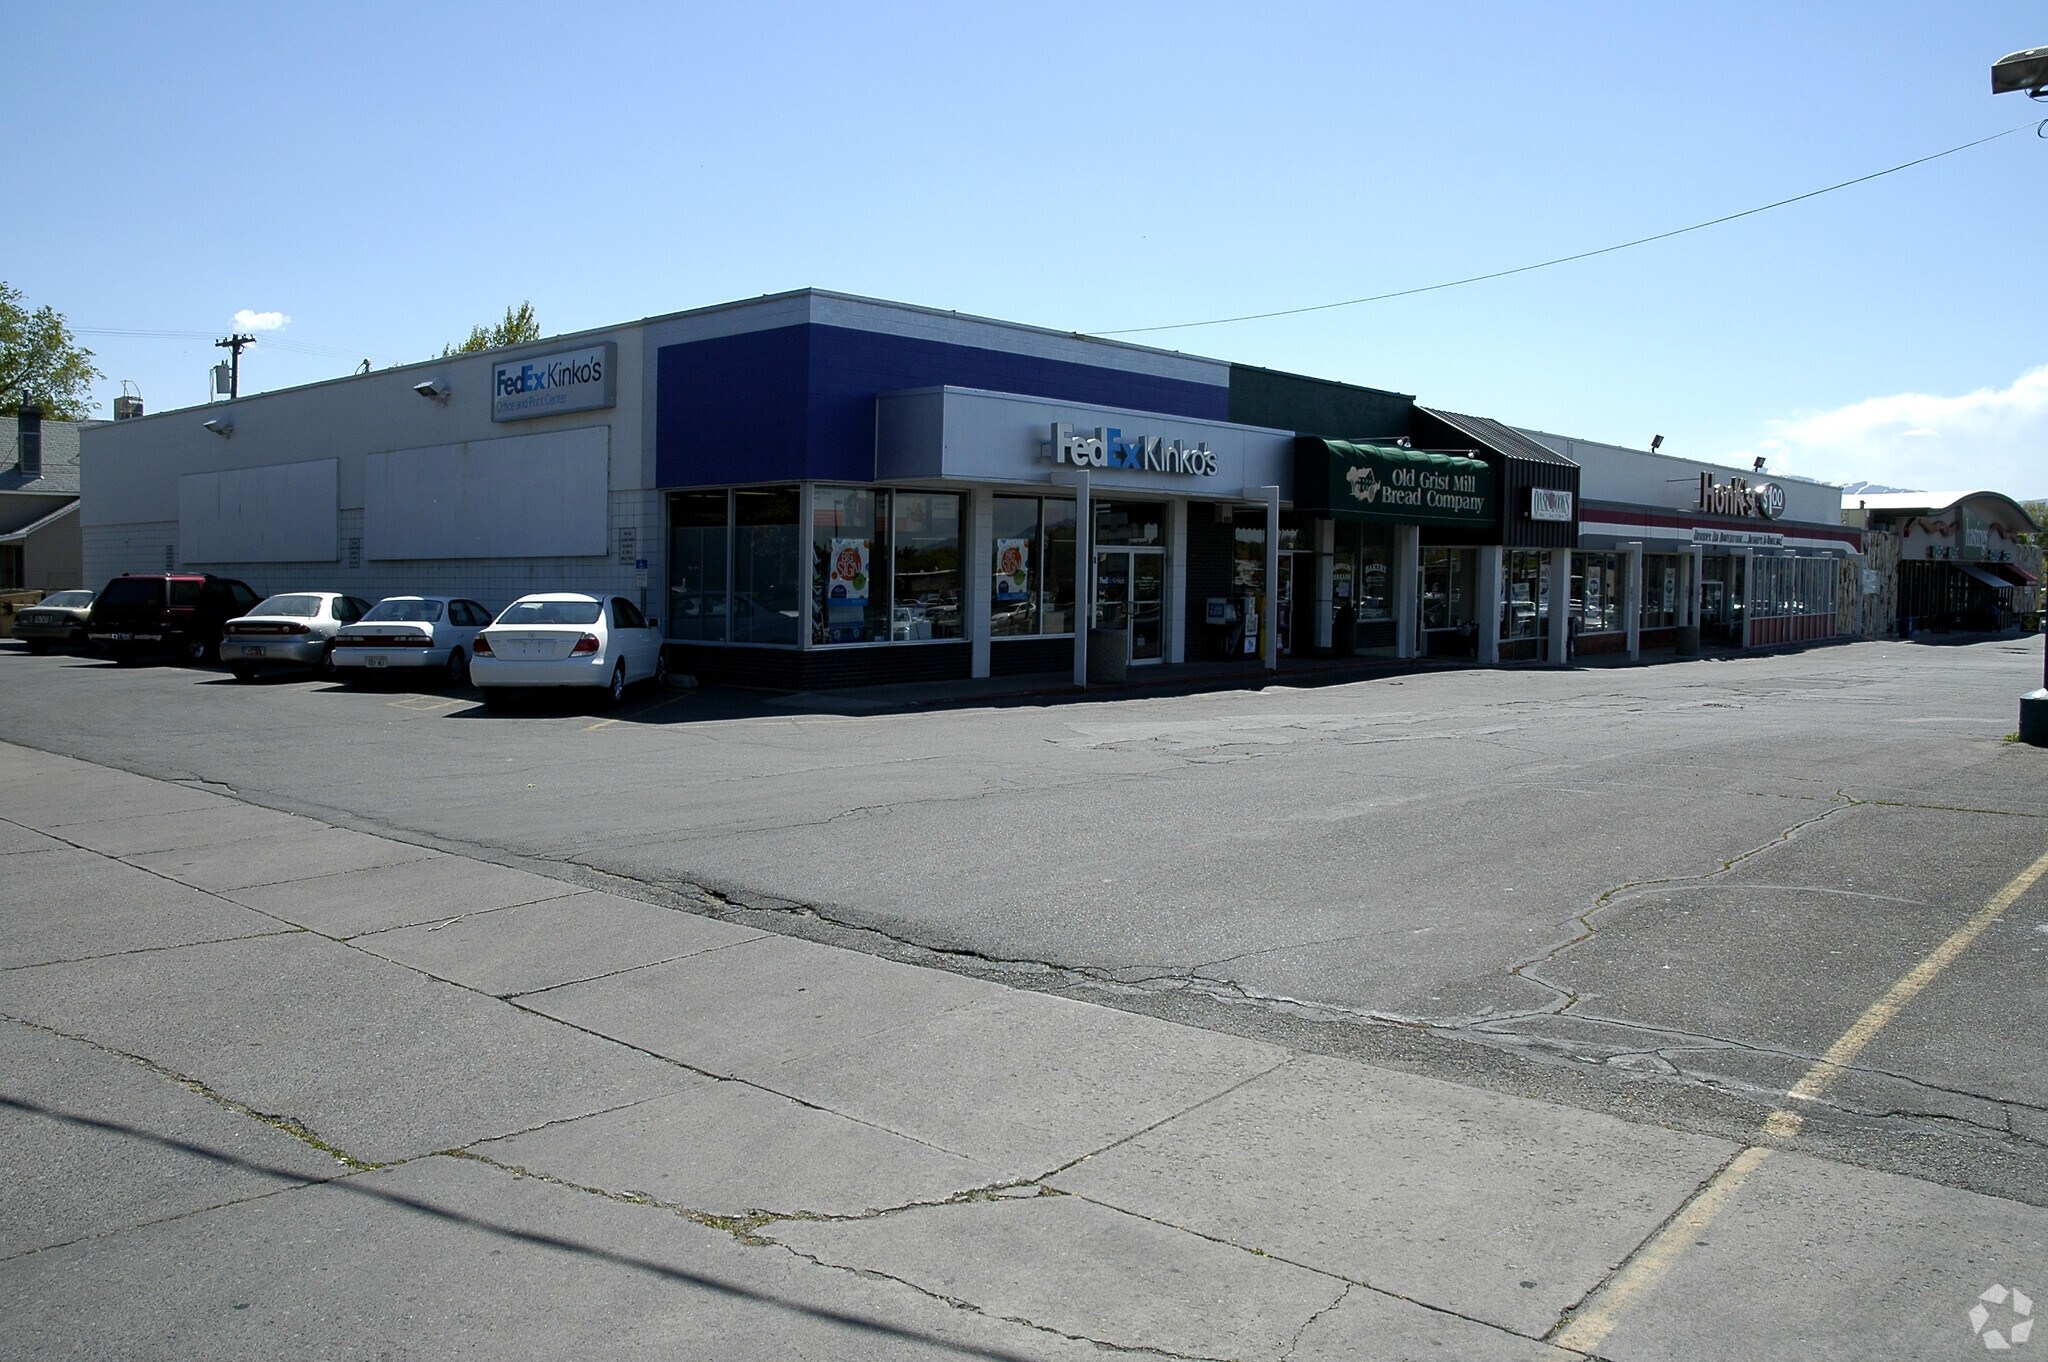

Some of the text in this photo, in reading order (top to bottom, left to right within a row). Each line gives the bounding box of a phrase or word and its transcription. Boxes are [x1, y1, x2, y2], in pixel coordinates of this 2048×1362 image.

[497, 355, 602, 397] FedEx Kinko's
[497, 393, 567, 413] Office and Print Center
[1051, 422, 1219, 477] FedEx Kinko's
[1392, 468, 1476, 493] Old Grist Mill
[1381, 486, 1485, 514] Bread Company
[841, 551, 853, 562] BIG
[837, 562, 860, 577] SIGN
